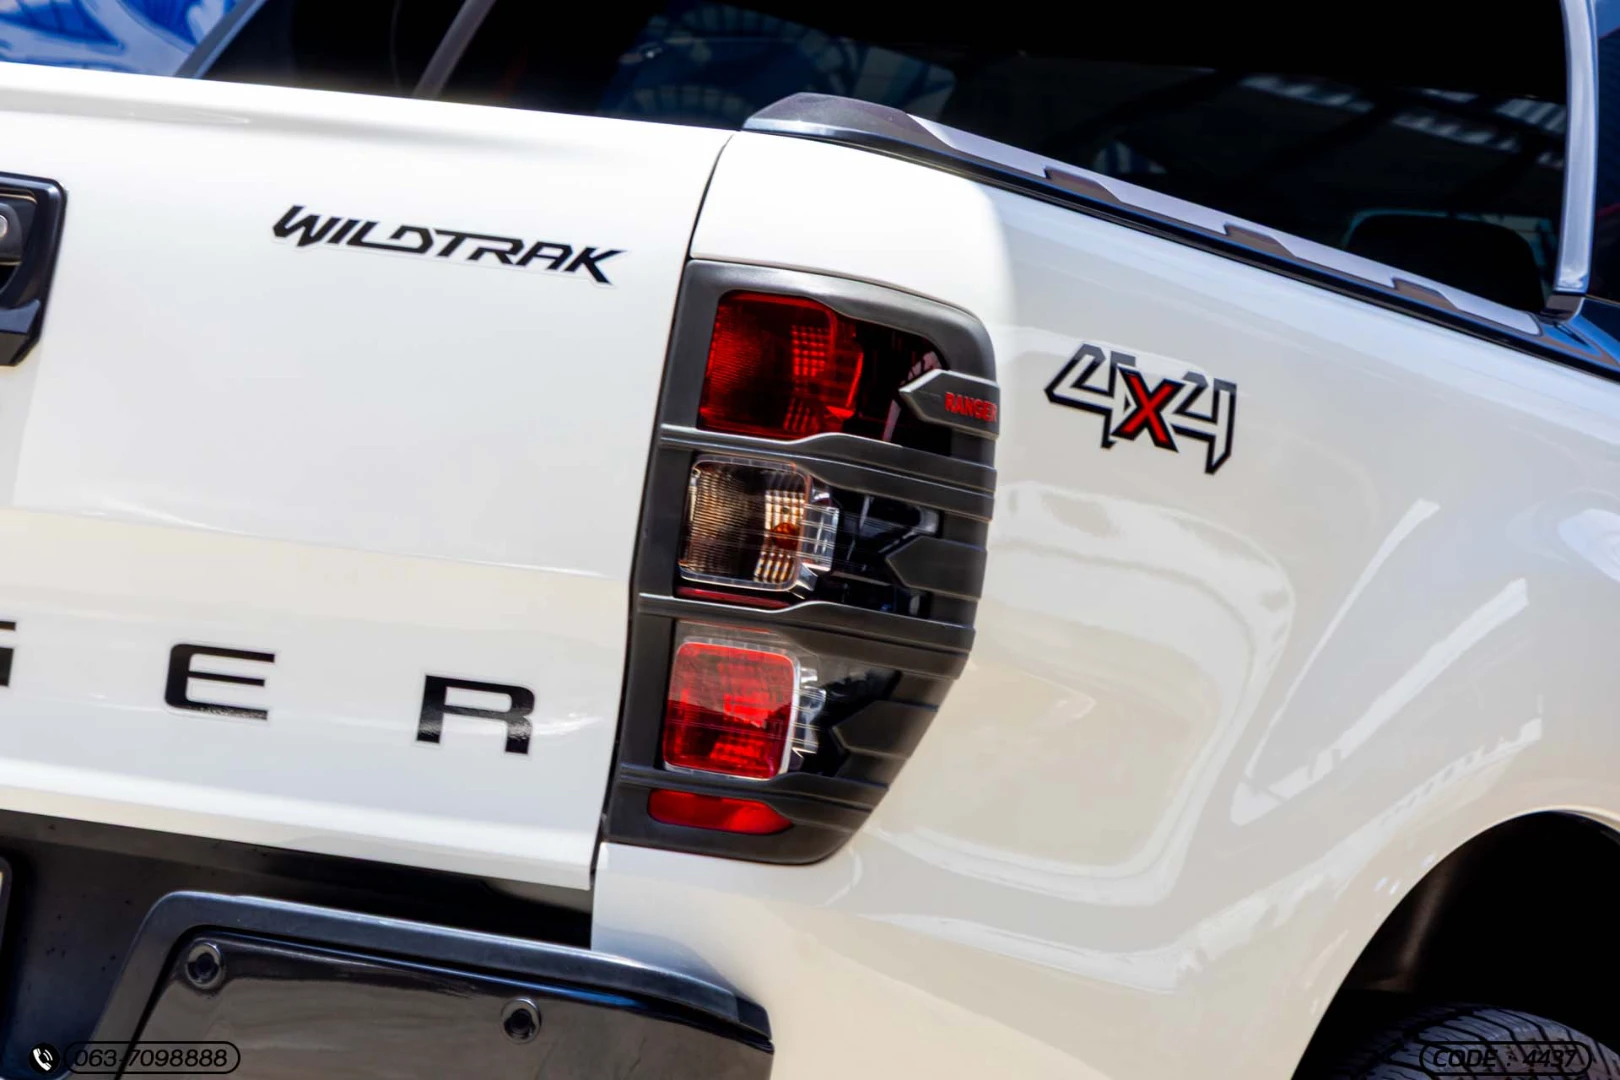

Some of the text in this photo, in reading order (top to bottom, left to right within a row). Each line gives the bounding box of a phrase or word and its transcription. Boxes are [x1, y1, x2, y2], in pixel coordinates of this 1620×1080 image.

[272, 204, 626, 285] WILDTRAK
[944, 391, 998, 422] RANGER
[0, 620, 537, 755] ER
